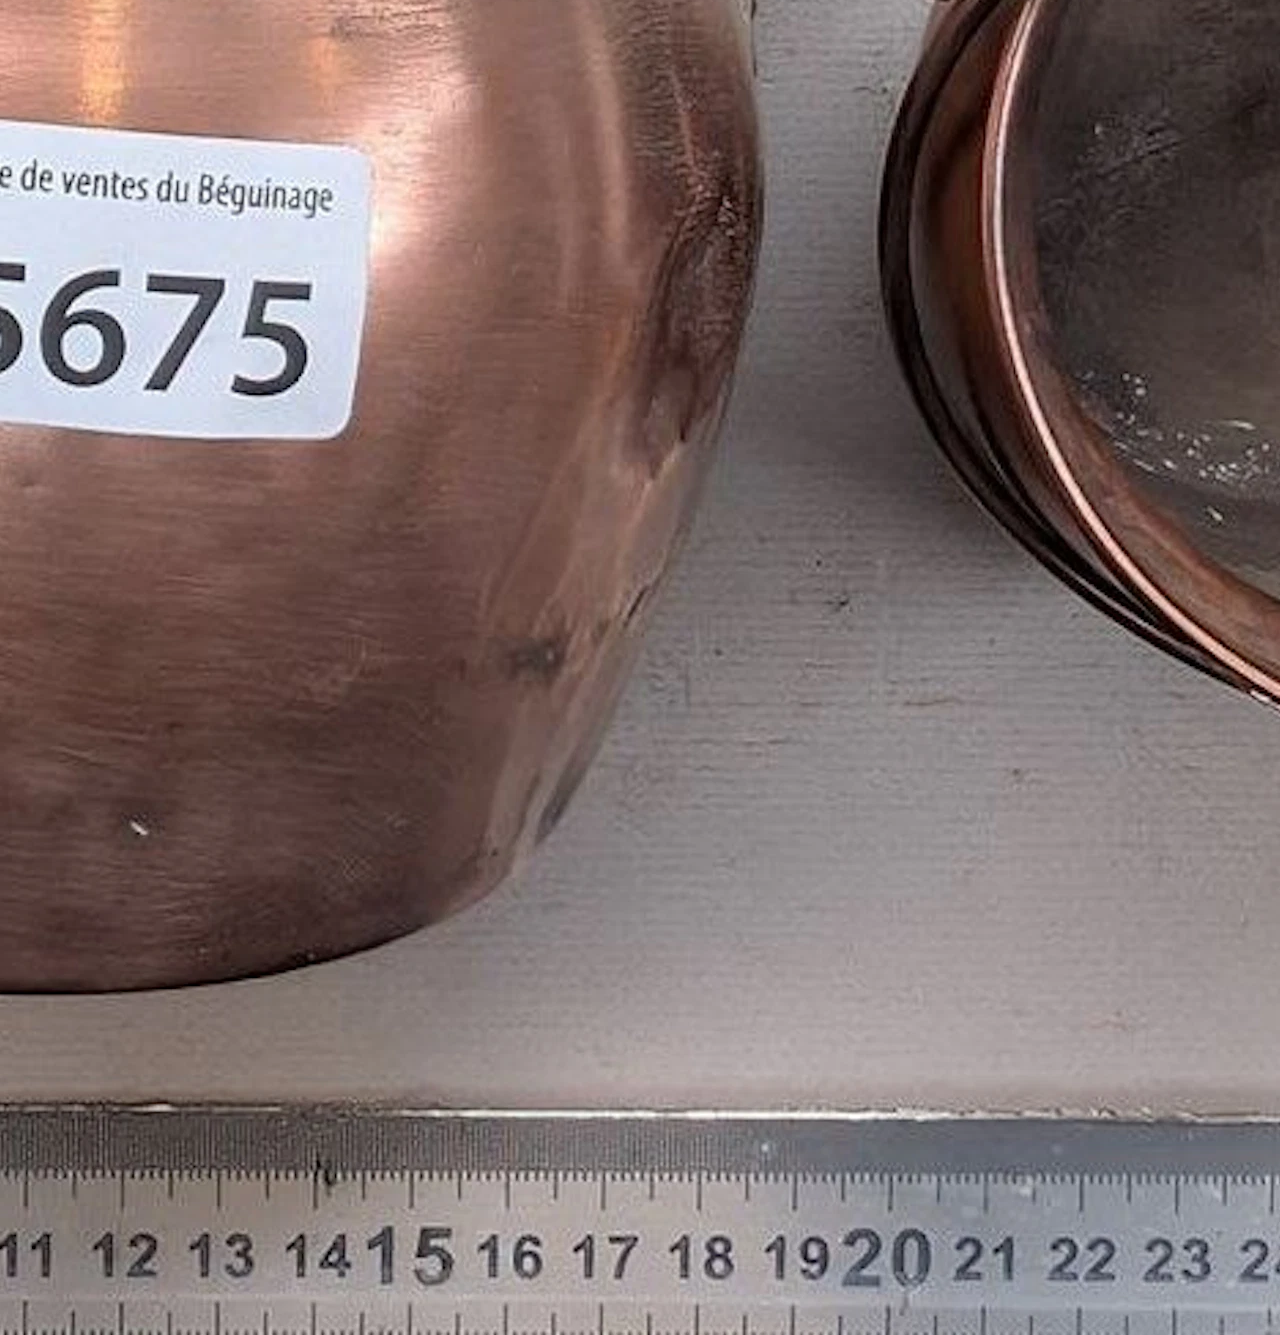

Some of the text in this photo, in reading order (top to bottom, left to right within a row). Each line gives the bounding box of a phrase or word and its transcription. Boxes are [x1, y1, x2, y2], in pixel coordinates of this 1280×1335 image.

[21, 159, 53, 192] de
[63, 172, 148, 200] ventes
[157, 171, 189, 203] du
[198, 174, 332, 219] Béguinage
[93, 1232, 157, 1277] 12
[189, 1233, 254, 1278] 13
[286, 1233, 351, 1277] 14
[367, 1226, 454, 1286] 15
[478, 1234, 542, 1279] 16
[573, 1234, 638, 1279] 17
[669, 1235, 734, 1279] 18
[765, 1235, 829, 1280] 19
[843, 1229, 931, 1287] 20
[954, 1236, 1014, 1281] 21
[1048, 1237, 1116, 1281] 22
[1143, 1237, 1211, 1282] 23
